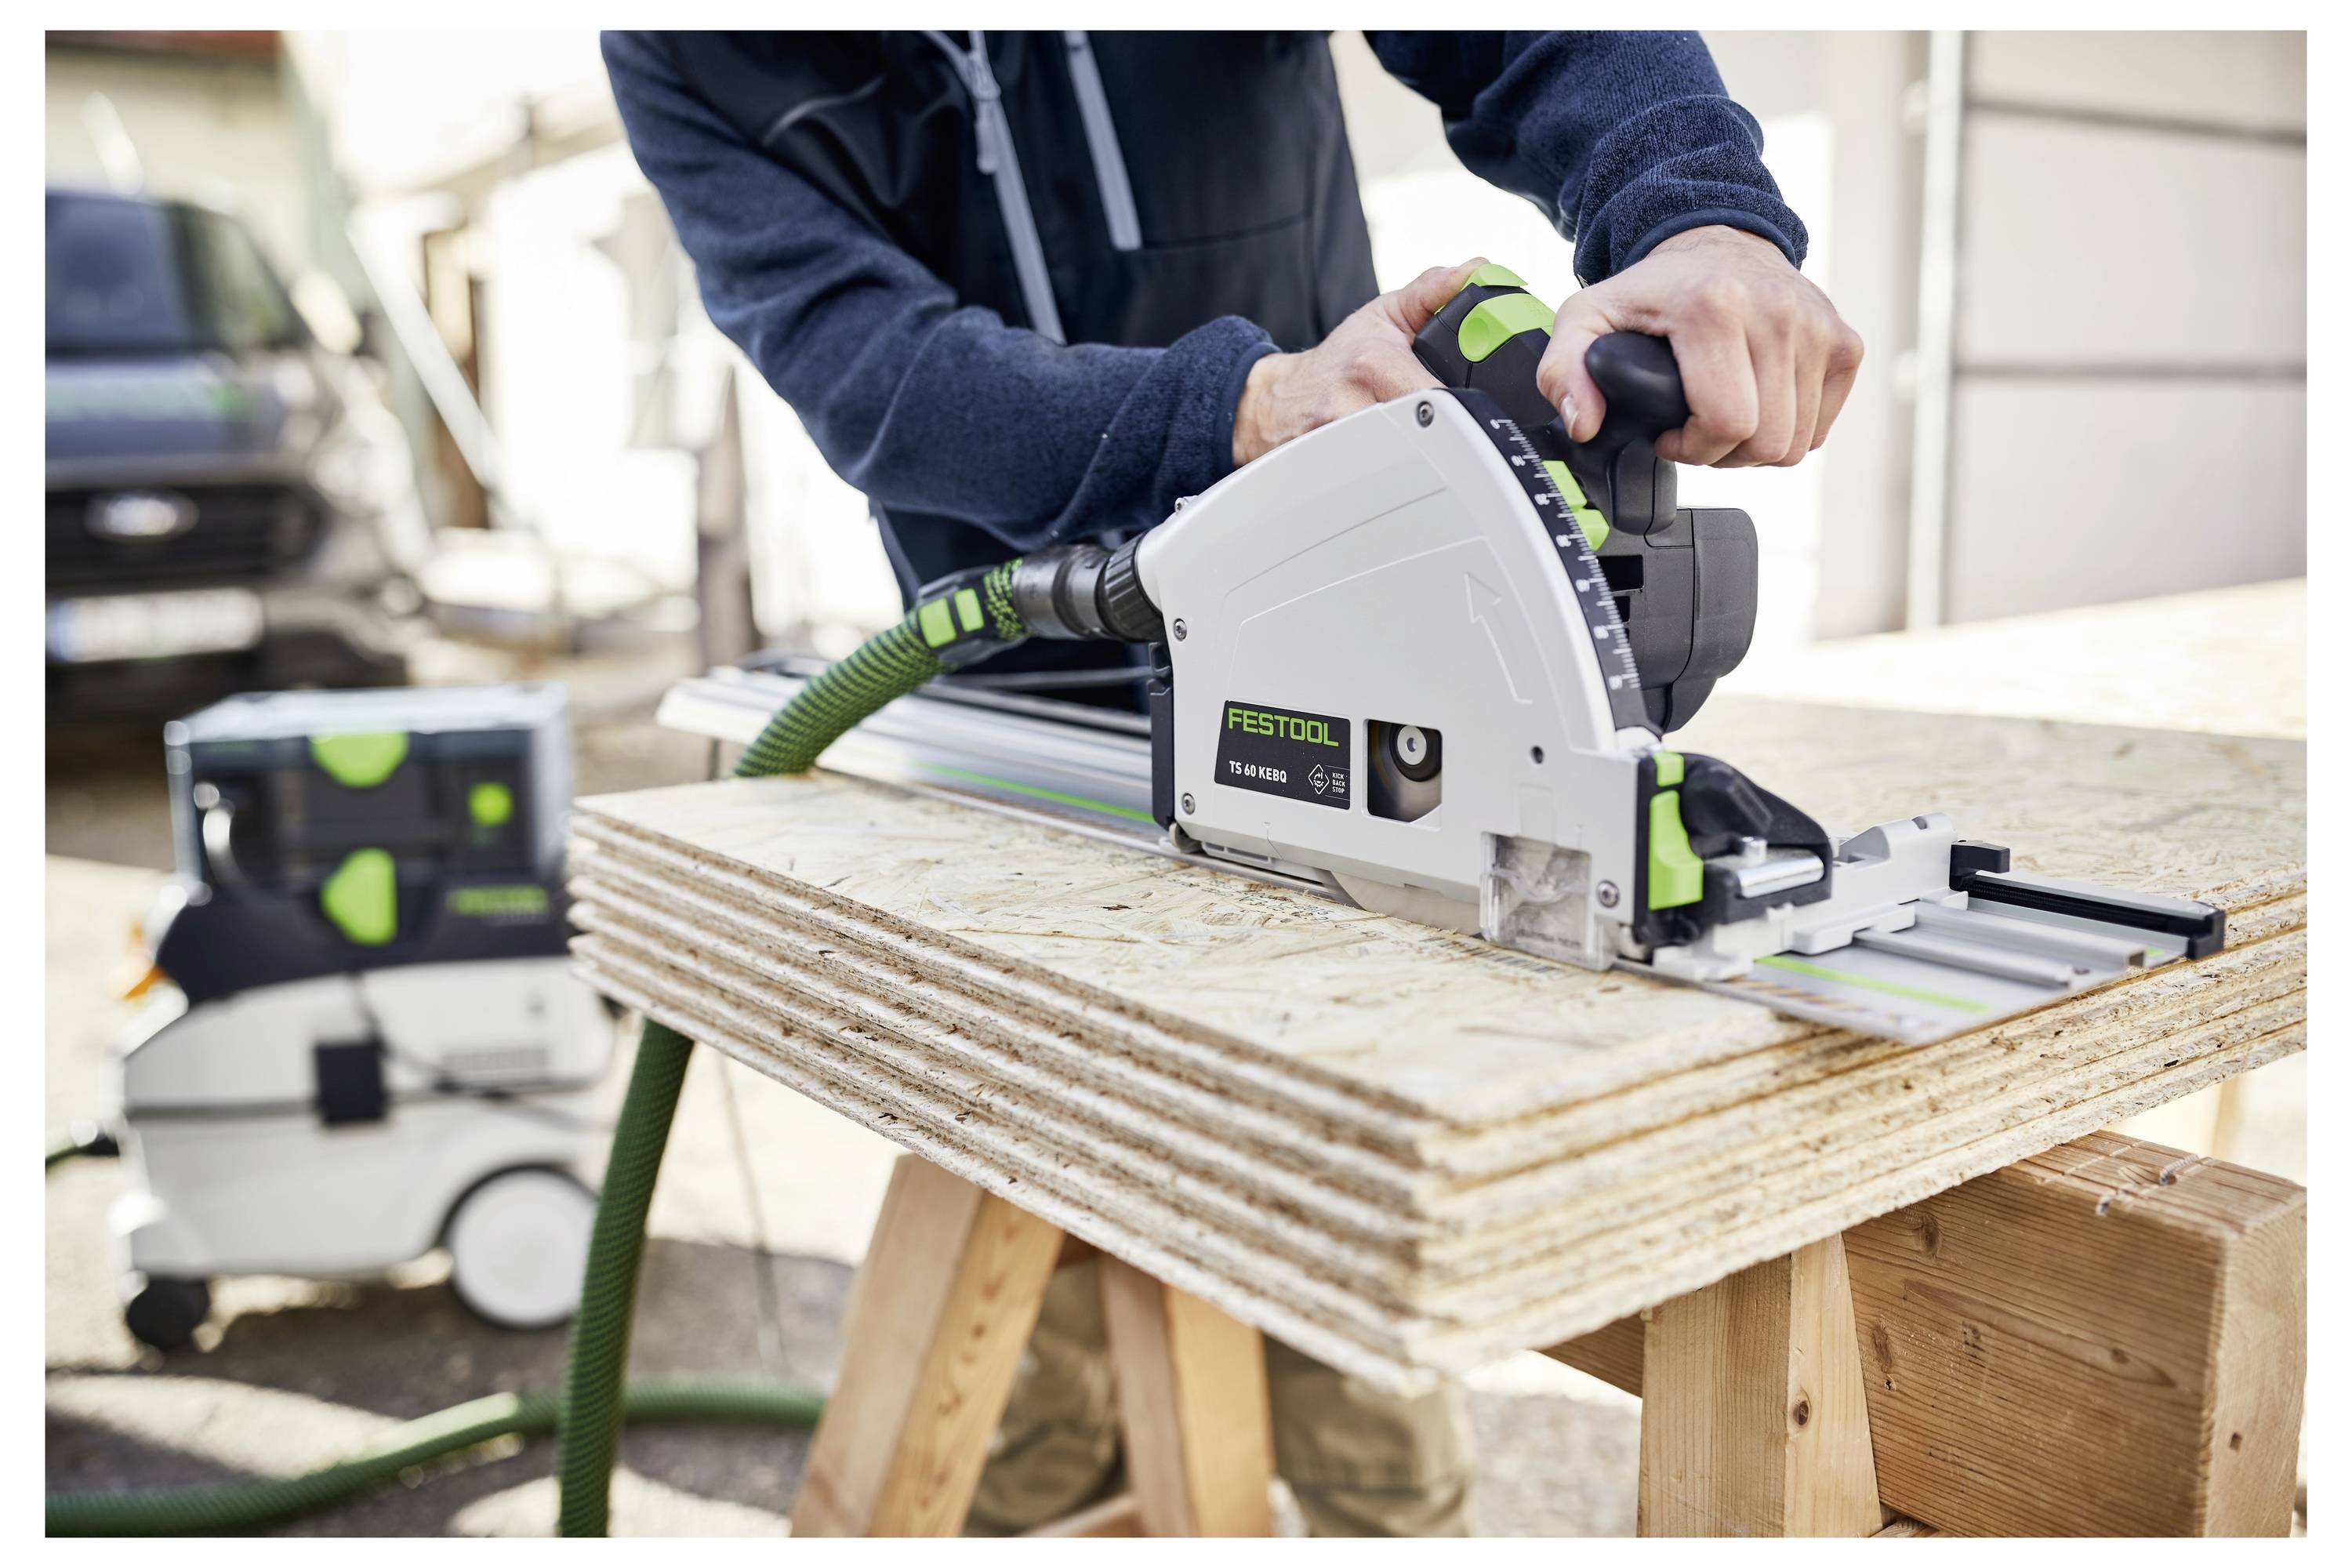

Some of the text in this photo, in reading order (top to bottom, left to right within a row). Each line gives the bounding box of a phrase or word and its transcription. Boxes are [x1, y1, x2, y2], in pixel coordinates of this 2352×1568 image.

[1229, 707, 1339, 747] FESTOOL
[1229, 760, 1287, 783] TS 60 KEBQ
[1332, 779, 1346, 787] BACK
[1332, 786, 1345, 794] STOP
